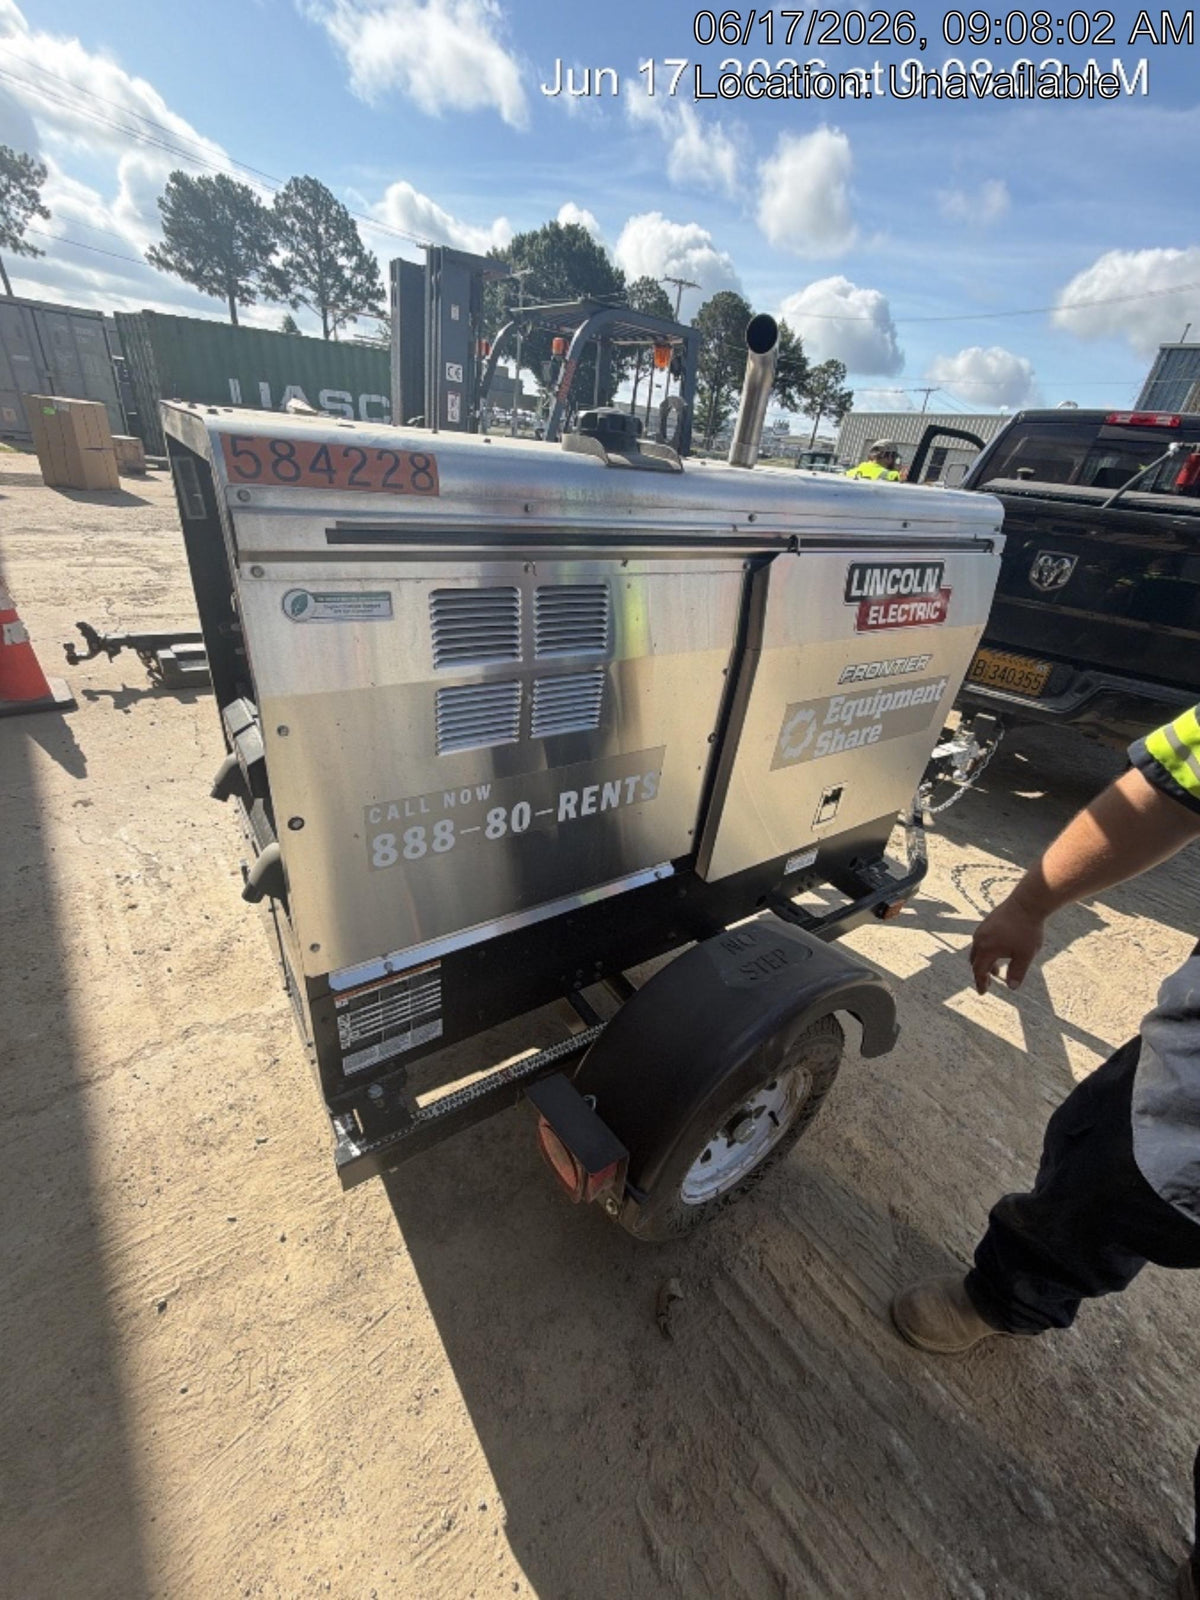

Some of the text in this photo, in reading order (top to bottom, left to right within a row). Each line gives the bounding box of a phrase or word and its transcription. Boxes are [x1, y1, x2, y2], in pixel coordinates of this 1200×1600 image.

[229, 435, 435, 492] 584228
[850, 566, 940, 597] LINCOLN
[867, 601, 942, 625] ELECTRIC
[837, 654, 933, 685] FRONTIER
[822, 678, 948, 727] Equipment
[813, 723, 883, 758] Share
[368, 783, 492, 825] CALL NOW
[720, 932, 759, 956] NO
[740, 948, 789, 981] STEP
